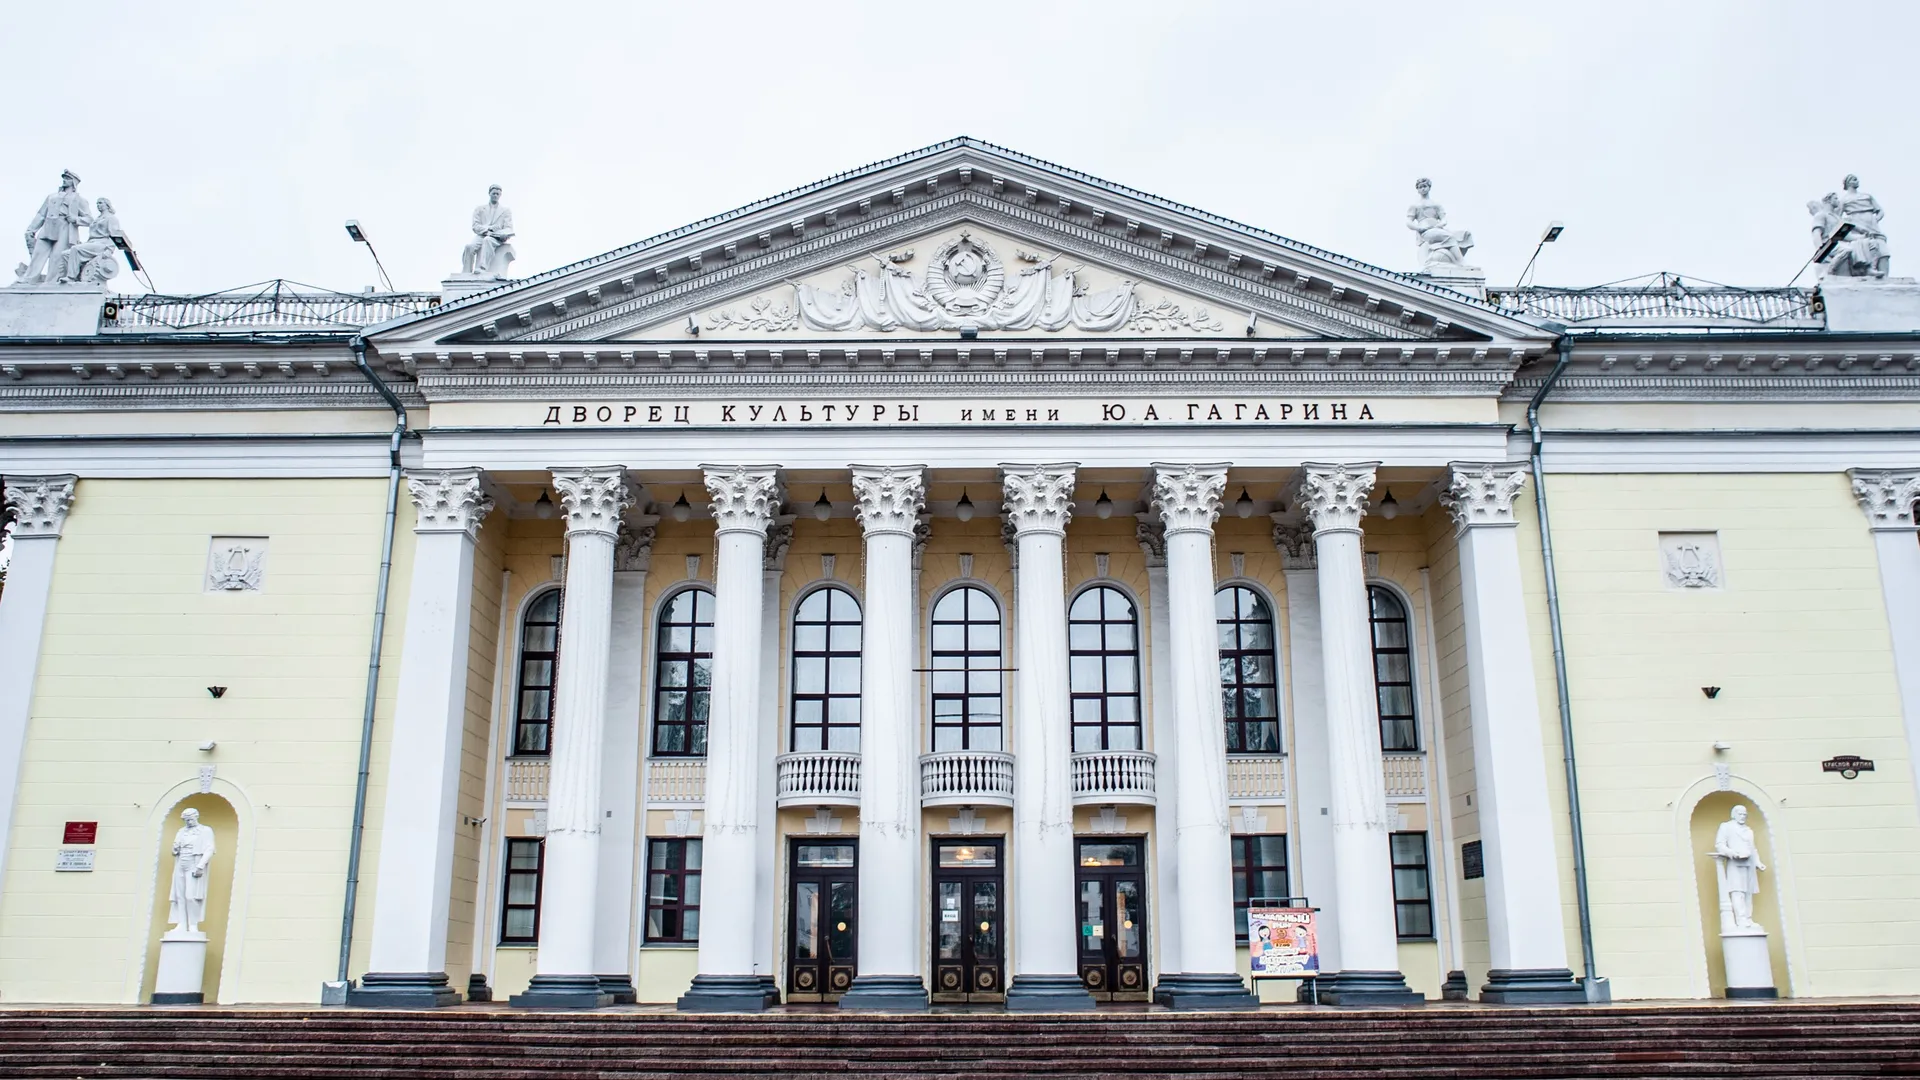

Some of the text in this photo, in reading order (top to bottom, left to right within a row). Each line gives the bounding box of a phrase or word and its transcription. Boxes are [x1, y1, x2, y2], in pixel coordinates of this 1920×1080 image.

[543, 405, 690, 425] ДВОРЕЦ
[721, 404, 919, 422] КУЛЬТУРЫ
[961, 408, 1059, 421] ИМЕНИ
[1187, 403, 1375, 421] ГАГАРИНА
